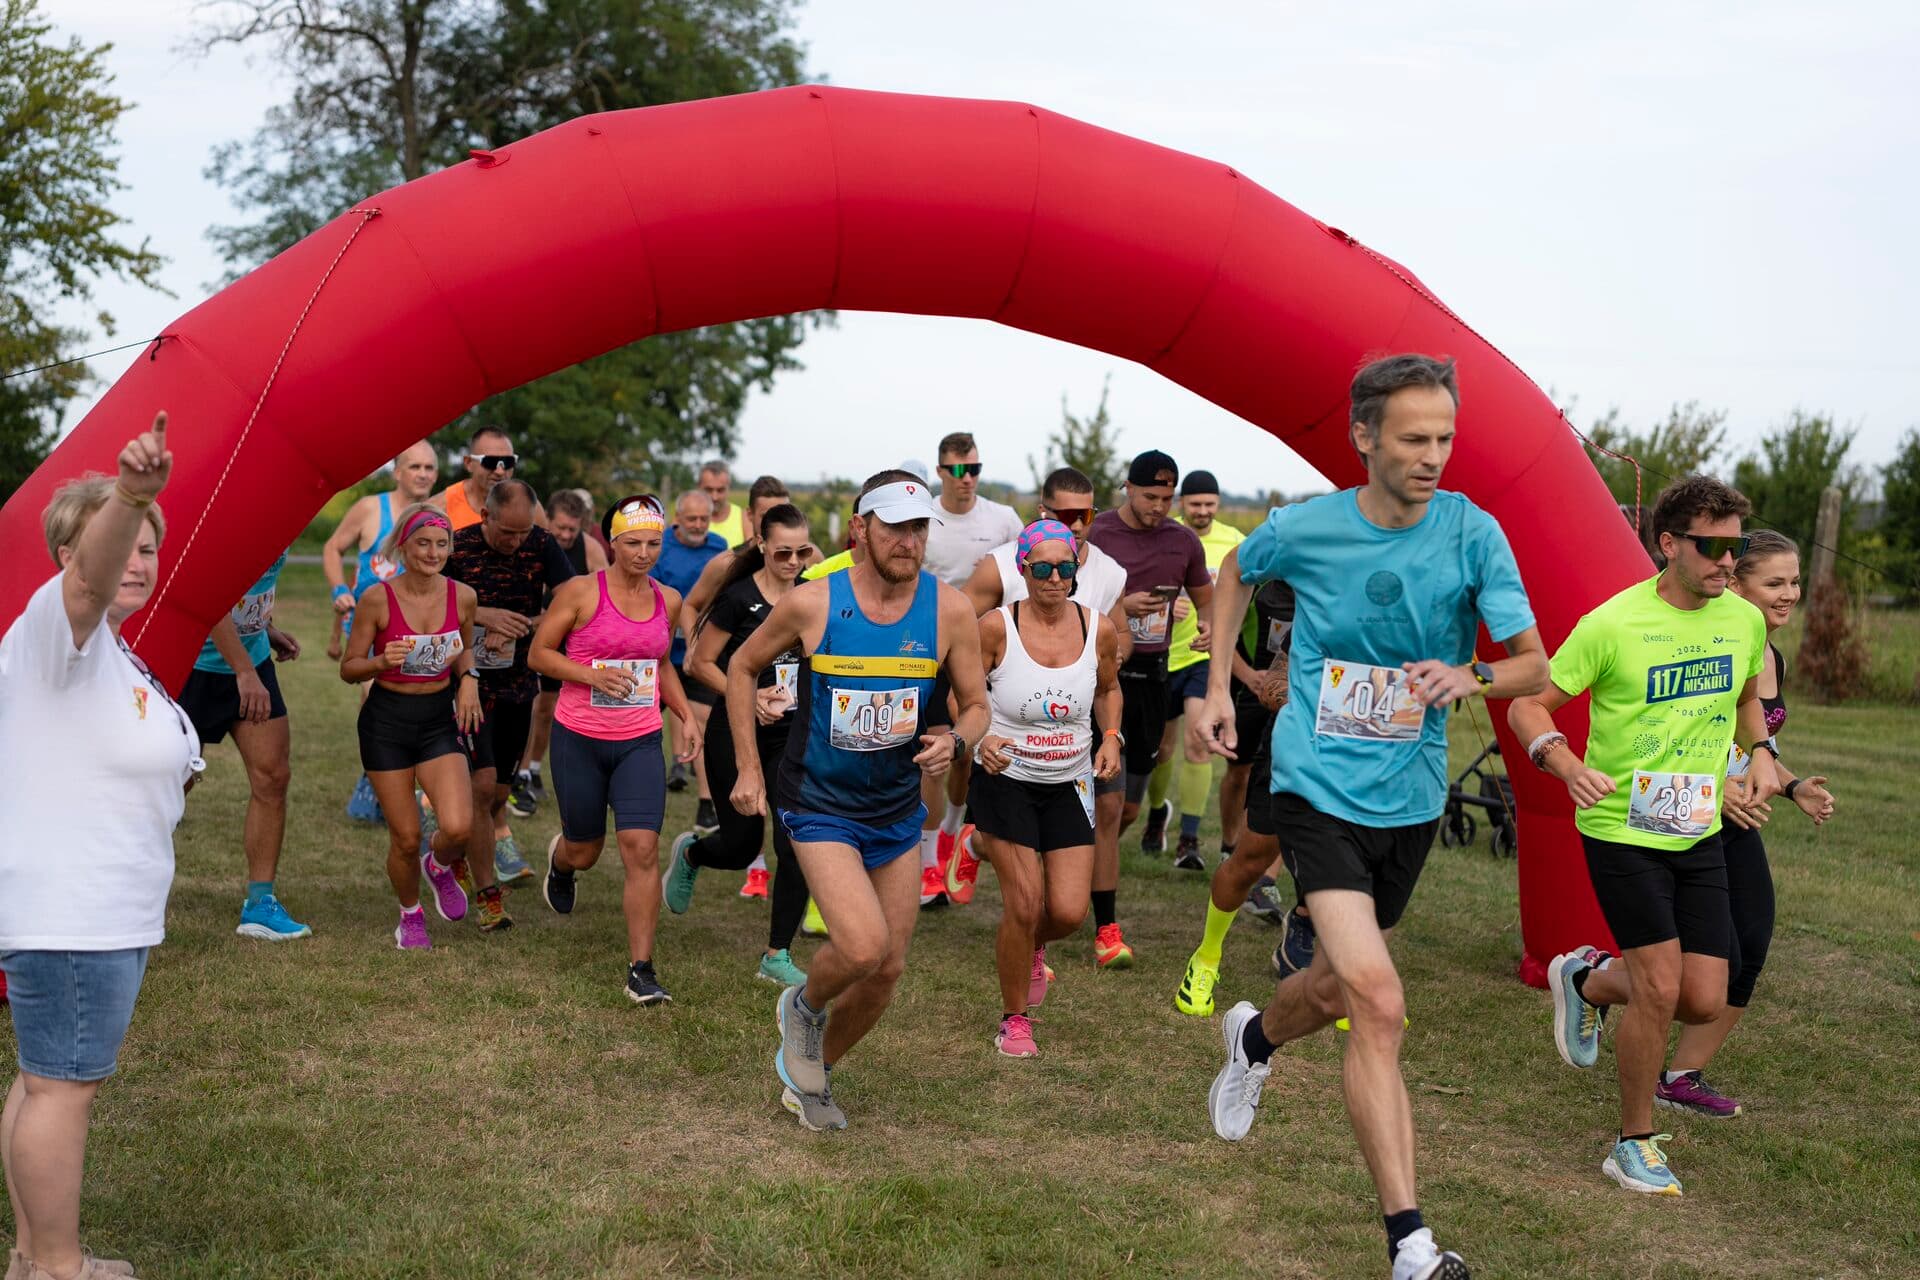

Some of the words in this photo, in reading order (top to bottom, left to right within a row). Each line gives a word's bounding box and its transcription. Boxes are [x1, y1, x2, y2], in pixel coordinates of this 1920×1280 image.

[423, 644, 447, 666] 23
[1676, 645, 1702, 655] 2025
[1651, 666, 1683, 699] 117
[1683, 673, 1729, 693] MISKOLC
[1034, 687, 1073, 701] OÁZA
[1352, 680, 1397, 724] 04
[858, 703, 894, 738] 09
[1681, 706, 1709, 717] 04.05
[1656, 785, 1693, 822] 28
